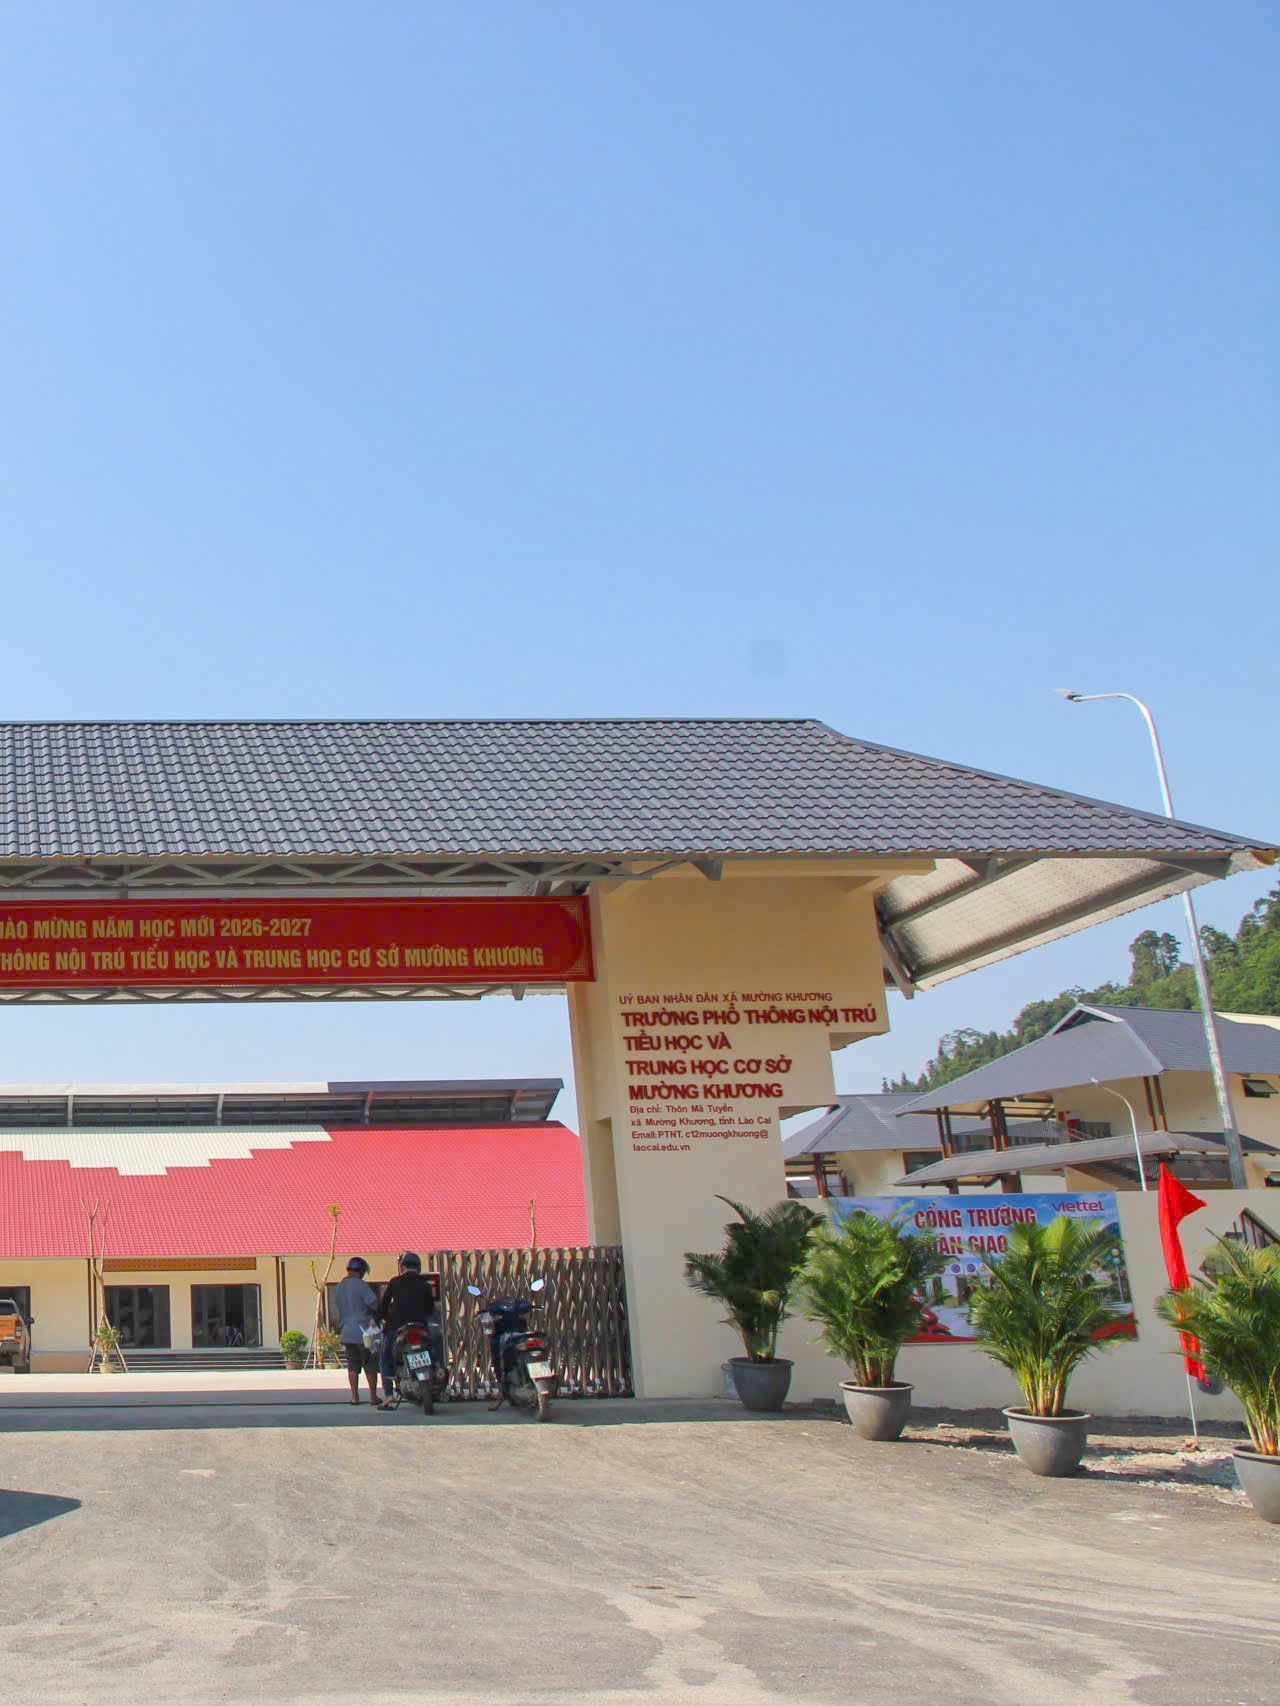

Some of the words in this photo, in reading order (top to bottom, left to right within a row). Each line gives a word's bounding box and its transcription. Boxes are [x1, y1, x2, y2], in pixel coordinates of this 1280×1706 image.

[34, 915, 87, 939] MỪNG
[92, 915, 133, 938] NĂM
[139, 919, 175, 942] HỌC
[181, 915, 215, 937] MỚI
[220, 918, 312, 937] 2026-2027
[56, 947, 86, 974] NỘI
[92, 947, 124, 970] TRÚ
[130, 943, 169, 970] TIỂU
[175, 950, 210, 973] HỌC
[215, 946, 239, 969] VÀ
[243, 949, 302, 969] TRUNG
[307, 949, 342, 973] HỌC
[348, 948, 370, 968] CƠ
[376, 942, 400, 968] SỞ
[405, 944, 468, 967] MƯỜNG
[474, 946, 544, 967] KHƯƠNG
[637, 995, 659, 1005] BAN
[663, 992, 693, 1004] NHÂN
[722, 991, 737, 1002] XÃ
[741, 990, 782, 1002] MƯỜNG
[786, 992, 833, 1002] KHƯƠNG
[620, 1007, 699, 1027] TRƯỜNG
[702, 1003, 740, 1025] PHỔ
[743, 1005, 806, 1025] THÔNG
[808, 1005, 839, 1027] NỘI
[841, 1003, 877, 1023] TRÚ
[623, 1029, 661, 1051] TIỂU
[664, 1035, 703, 1054] HỌC
[707, 1031, 731, 1051] VÀ
[625, 1059, 687, 1076] TRUNG
[690, 1058, 728, 1079] HỌC
[733, 1058, 761, 1075] CƠ
[765, 1054, 793, 1075] SỞ
[628, 1081, 698, 1101] MƯỜNG
[703, 1083, 783, 1100] KHƯƠNG
[629, 1105, 644, 1115] Địa
[665, 1105, 688, 1113] Thôn
[691, 1104, 704, 1113] Mã
[631, 1118, 641, 1126] xã
[679, 1116, 717, 1127] Khương,
[719, 1115, 735, 1125] tỉnh
[738, 1116, 754, 1125] Lào
[757, 1116, 772, 1125] Cai
[631, 1131, 657, 1139] Email:
[633, 1143, 690, 1152] laocai.edu.vn
[914, 1202, 963, 1229] CỔNG
[966, 1203, 1036, 1228] TRƯỜNG
[1052, 1200, 1105, 1213] viettel
